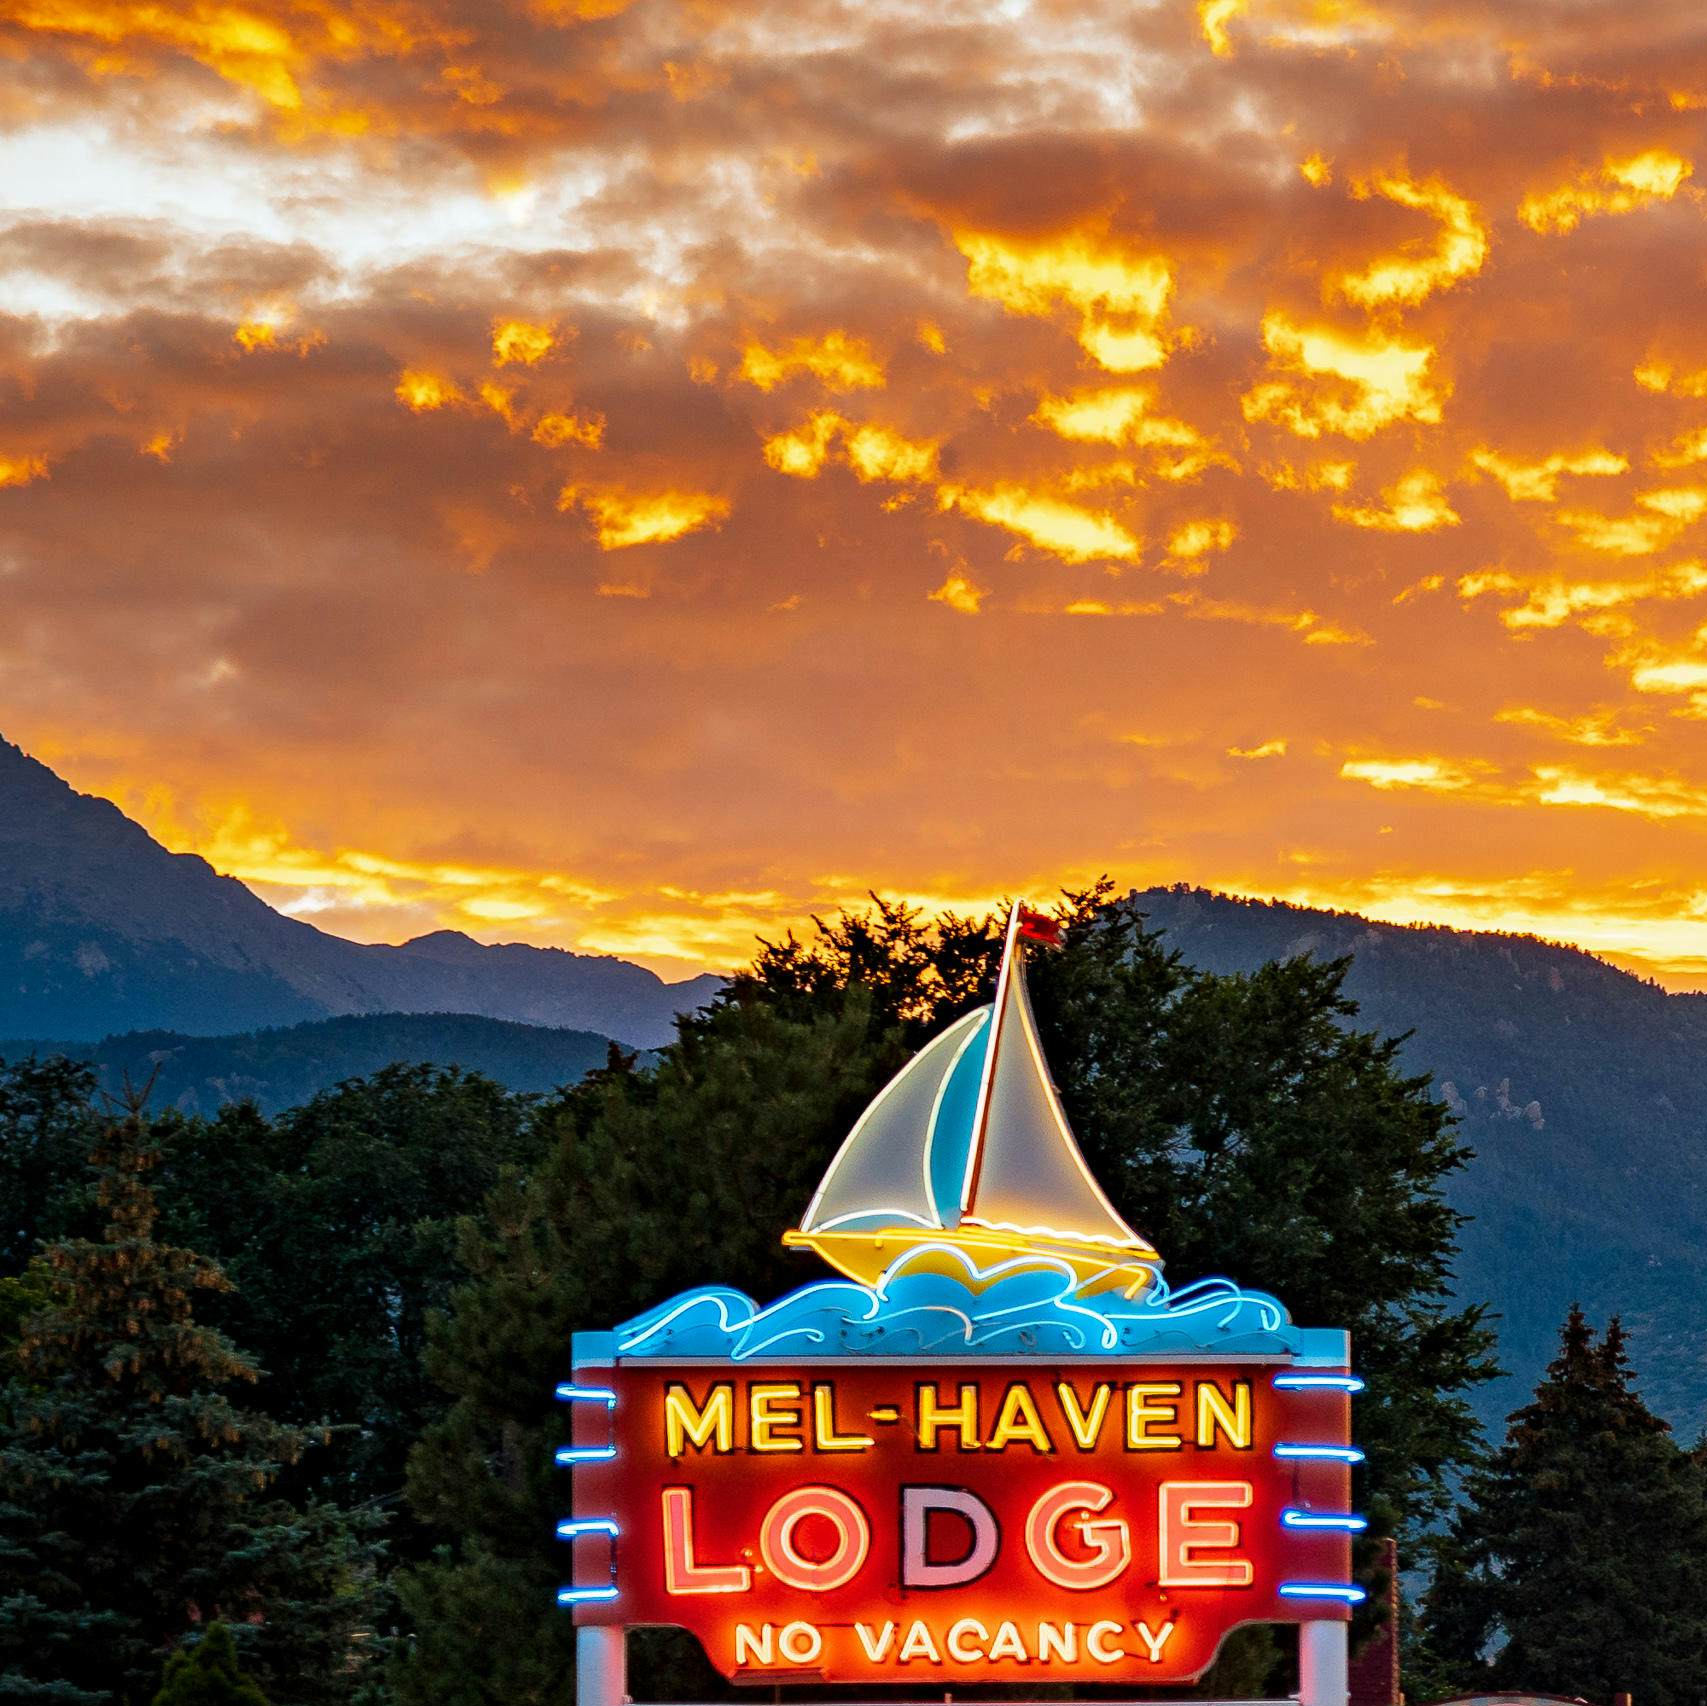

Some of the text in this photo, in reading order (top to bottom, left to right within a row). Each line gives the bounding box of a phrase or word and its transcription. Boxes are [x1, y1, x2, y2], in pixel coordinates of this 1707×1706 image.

[664, 1382, 1252, 1457] MEL-HAVEN
[661, 1480, 1253, 1594] LODGE
[734, 1619, 1175, 1665] NO VACANCY
